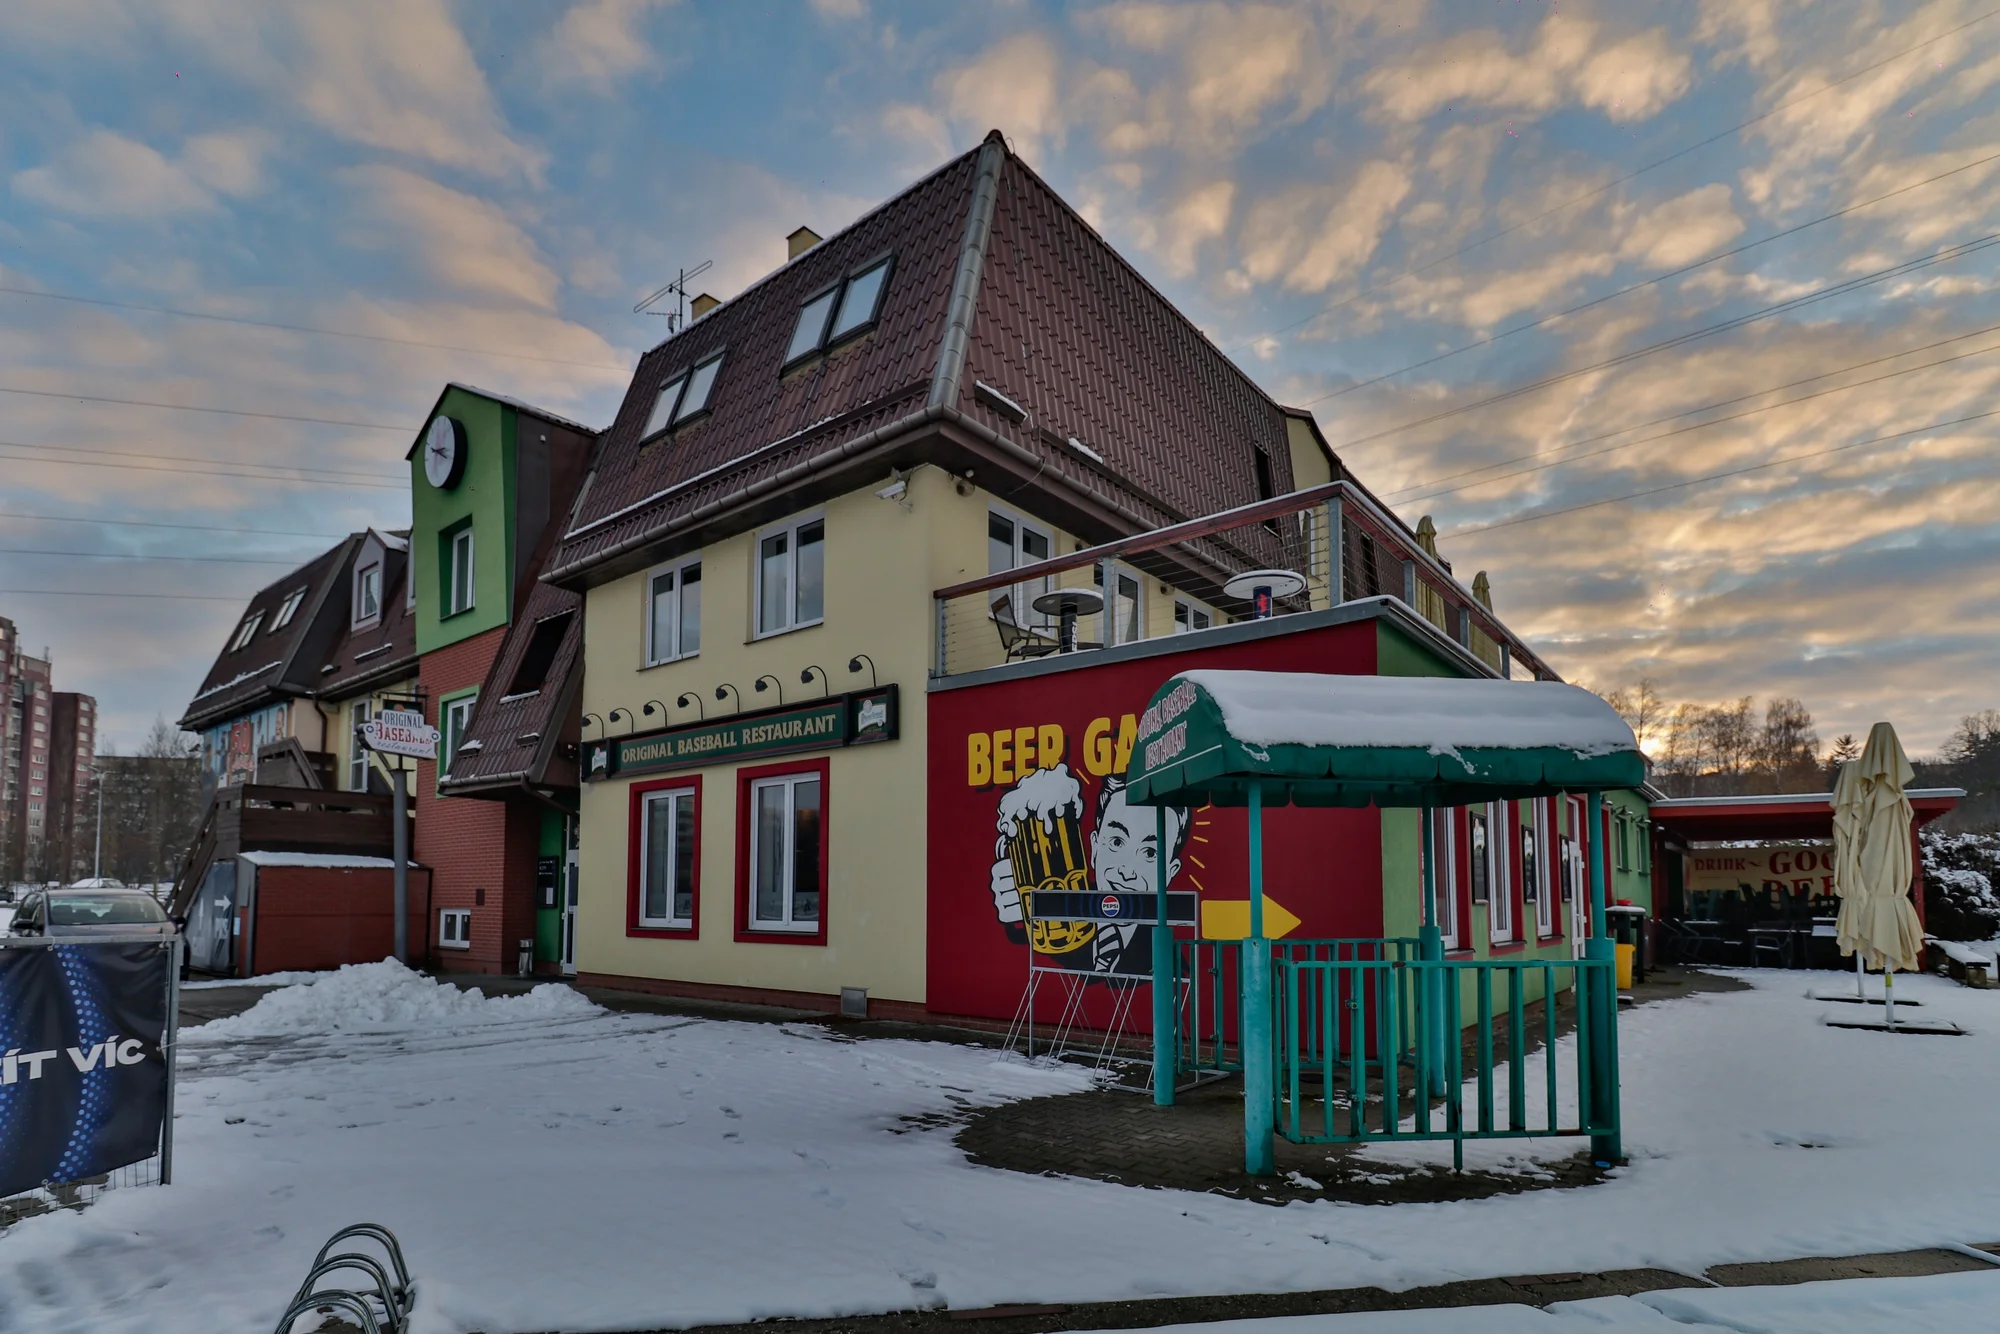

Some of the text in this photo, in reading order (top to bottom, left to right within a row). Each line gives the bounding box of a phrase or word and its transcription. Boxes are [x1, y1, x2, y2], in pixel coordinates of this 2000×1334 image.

[384, 712, 423, 729] ORIGINAL
[1161, 680, 1197, 724] BASEBALL
[374, 721, 432, 745] BASEB
[377, 741, 432, 754] restaurant
[621, 741, 673, 763] ORIGINAL
[677, 731, 737, 755] BASEBALL
[742, 714, 837, 745] RESTAURANT
[968, 723, 1064, 787] BEER
[1145, 720, 1187, 771] RESTAURANT
[1694, 857, 1746, 871] DRINK
[0, 1034, 147, 1085] ÍT VÍC
